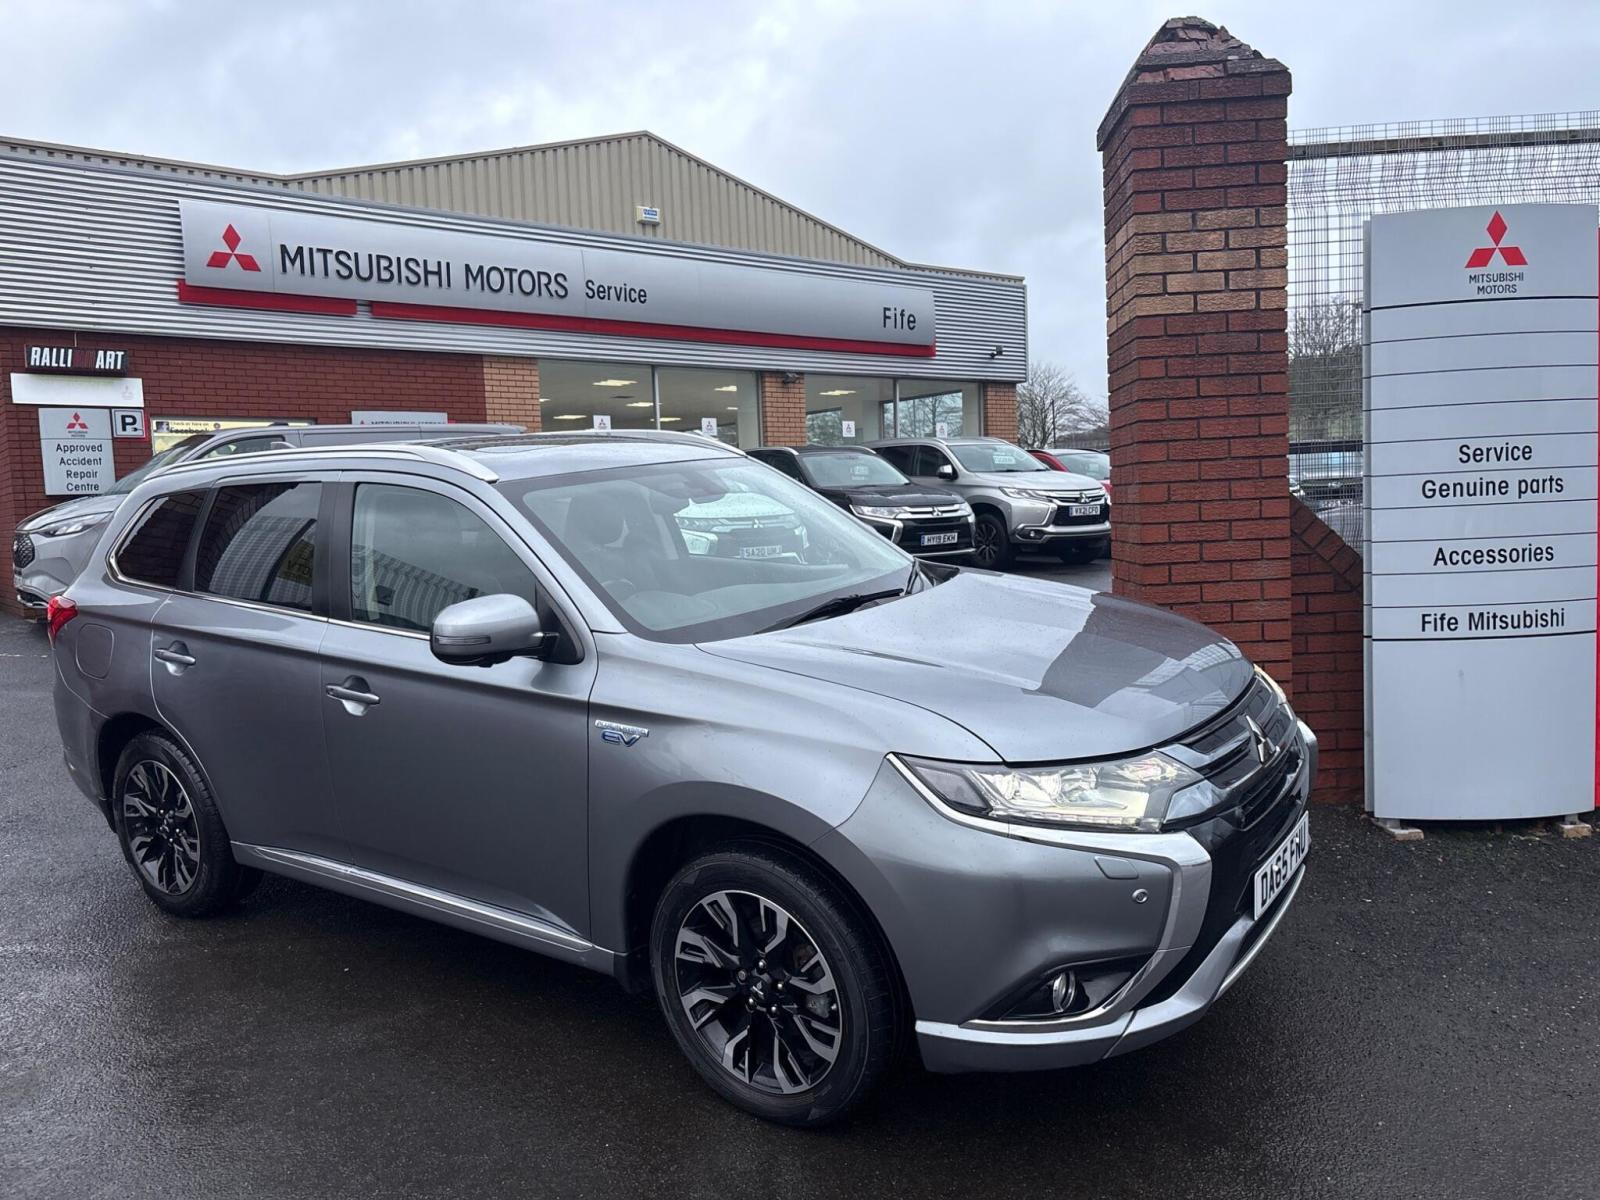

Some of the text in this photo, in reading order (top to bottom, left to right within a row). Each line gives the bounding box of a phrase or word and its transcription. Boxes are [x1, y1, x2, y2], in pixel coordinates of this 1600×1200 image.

[279, 243, 648, 304] MITSUBISHI MOTORS Service
[1469, 272, 1524, 284] MITSUBISHI
[1477, 284, 1517, 295] MOTORS
[882, 306, 916, 331] Fife
[30, 346, 125, 370] RALLI ART
[121, 414, 137, 432] P
[56, 443, 103, 454] Approved
[1458, 442, 1533, 464] Service
[59, 457, 102, 466] Accident
[66, 470, 98, 480] Repair
[66, 483, 100, 492] Centre
[1421, 474, 1564, 499] Genuine parts
[927, 533, 955, 544] HY19 EKH
[1433, 543, 1554, 566] Accessories
[1421, 608, 1565, 633] Fife Mitsubishi
[1261, 846, 1288, 909] DA65
